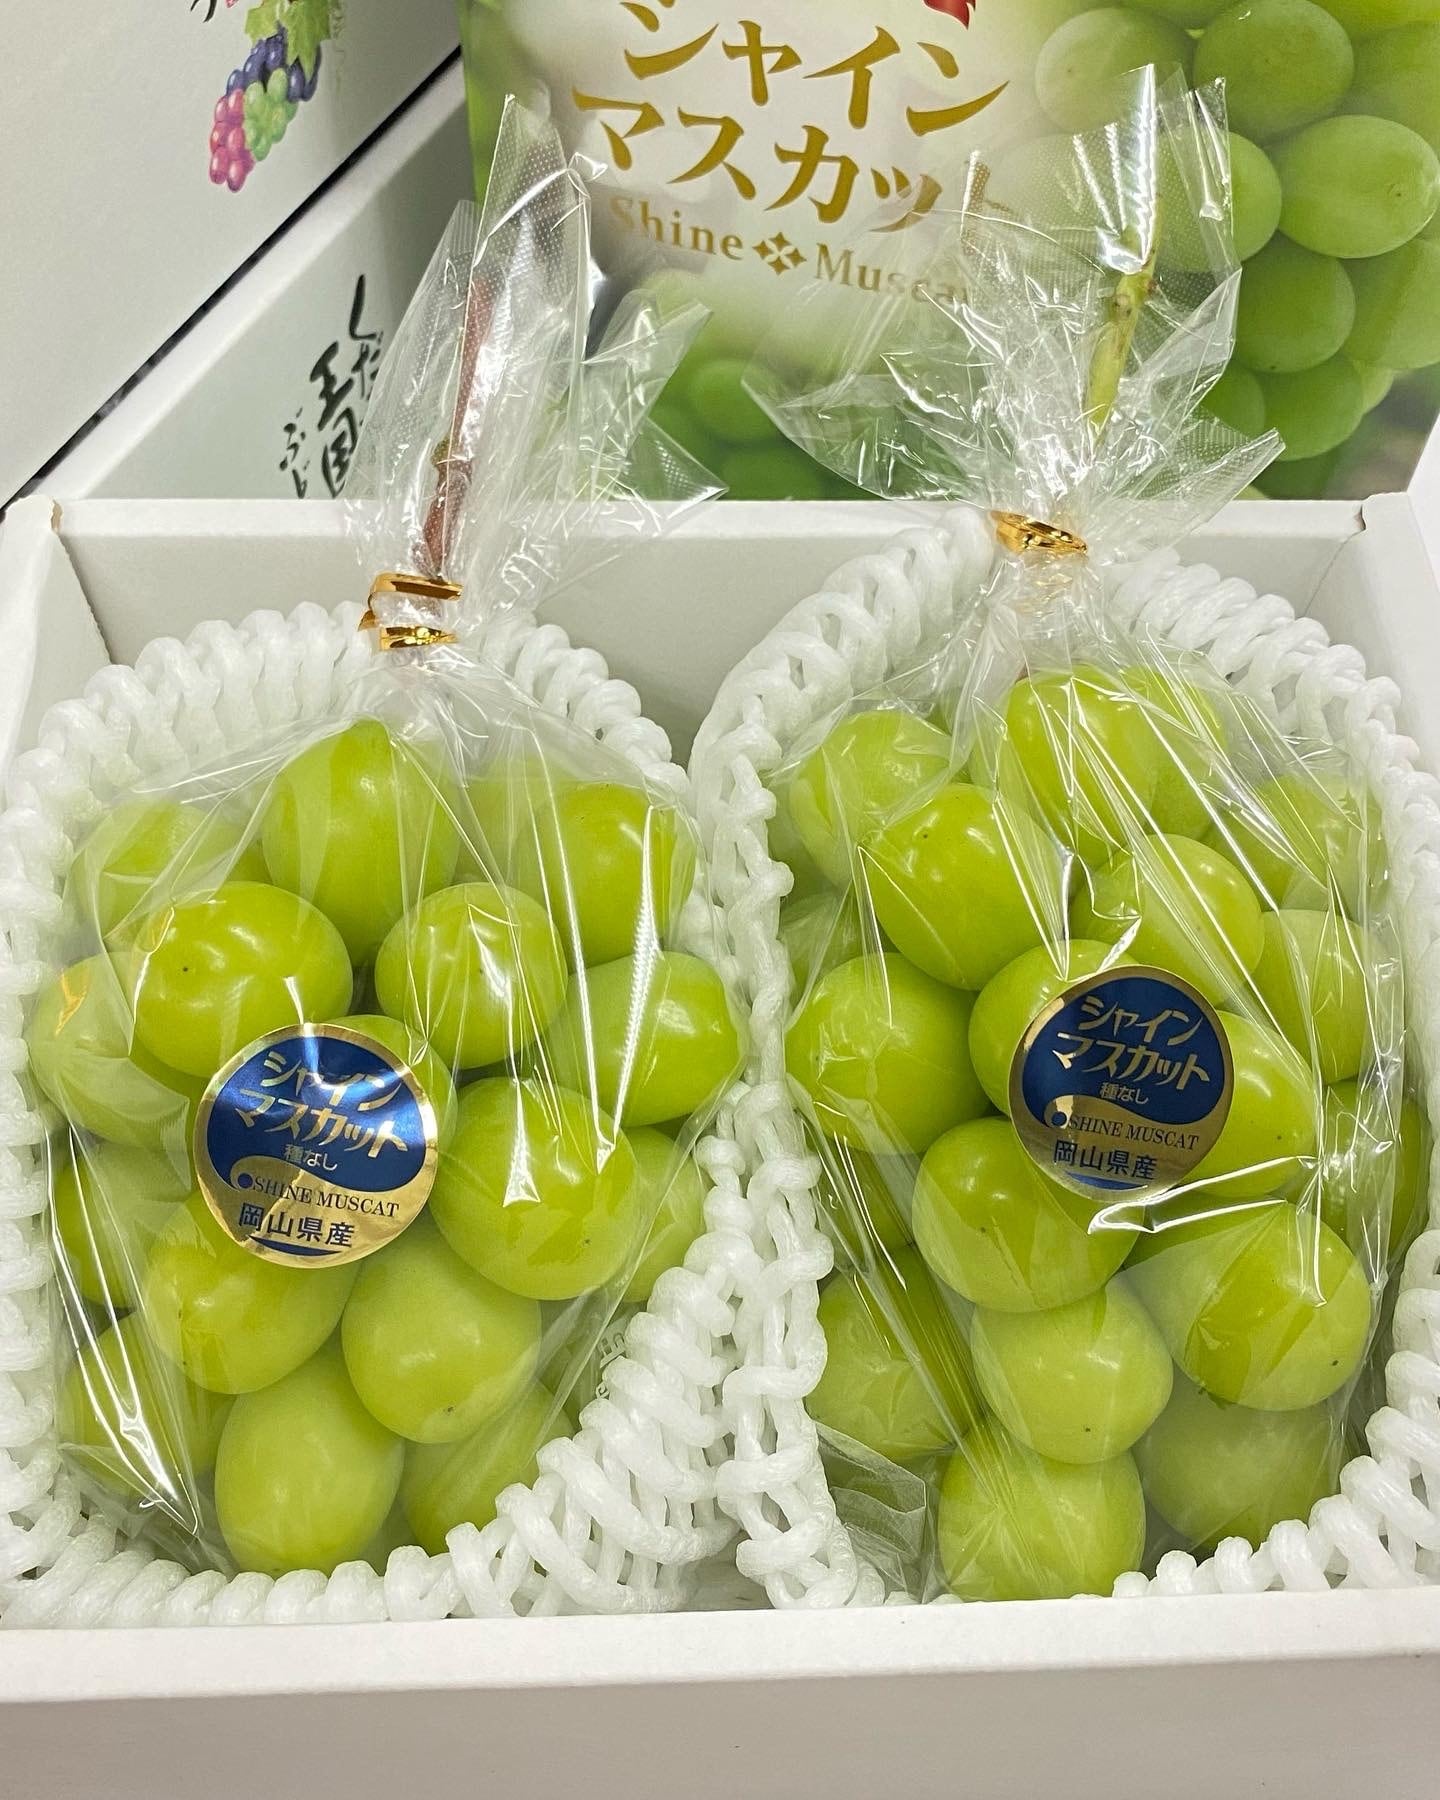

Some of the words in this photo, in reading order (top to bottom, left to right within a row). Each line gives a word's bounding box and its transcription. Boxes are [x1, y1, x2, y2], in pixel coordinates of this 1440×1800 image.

[625, 0, 1010, 137] シャイン
[572, 86, 1014, 256] マスカット
[608, 196, 746, 261] Shine
[815, 242, 968, 306] Musca
[1077, 995, 1204, 1047] シャイン
[260, 1051, 403, 1112] シャイン
[1052, 1032, 1211, 1091] マスカット
[1099, 1082, 1149, 1105] 種なし
[235, 1087, 409, 1159] マスカット
[1068, 1114, 1124, 1138] SHINE
[1125, 1124, 1200, 1151] MUSCAT
[283, 1143, 338, 1171] 種なし
[1053, 1140, 1159, 1181] 岡山県産
[253, 1176, 313, 1204] SHINE
[316, 1190, 401, 1219] MUSCAT
[239, 1202, 355, 1248] 岡山県産
